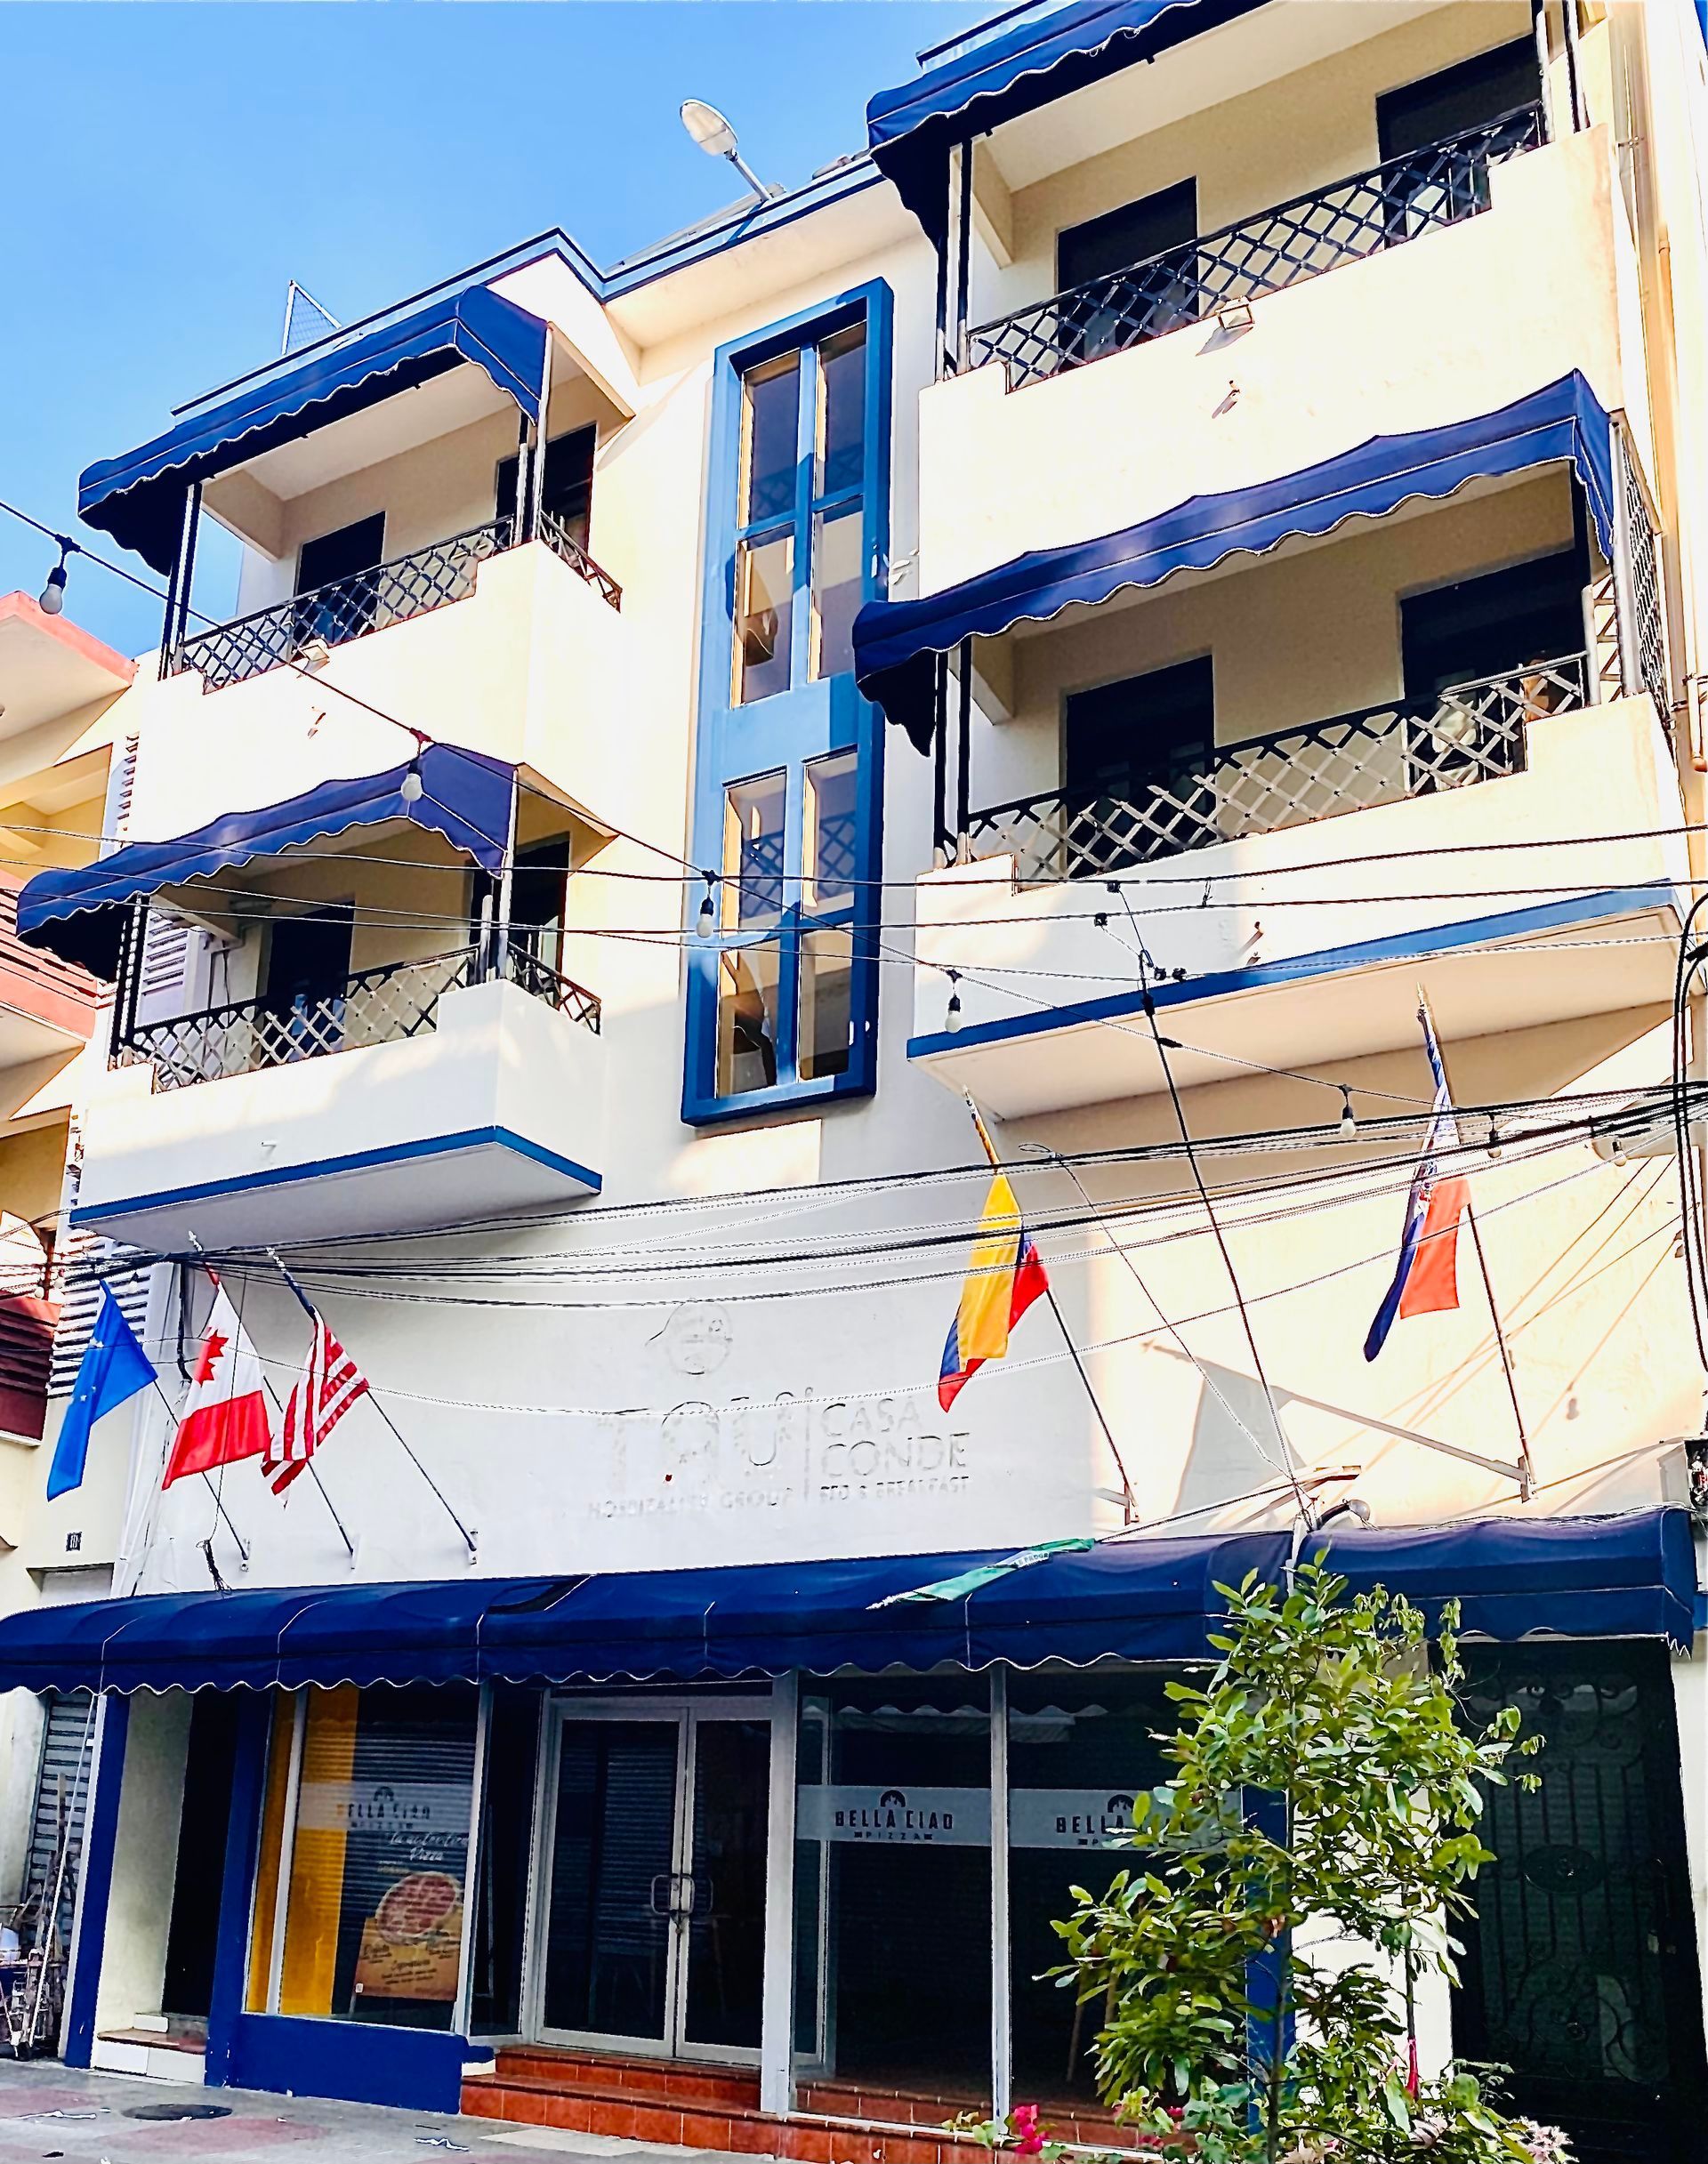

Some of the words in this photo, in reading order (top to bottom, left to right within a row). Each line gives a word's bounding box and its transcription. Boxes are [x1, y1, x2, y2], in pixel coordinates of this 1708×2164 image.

[821, 1397, 922, 1436] CASA
[822, 1433, 970, 1476] CONDE
[834, 1809, 896, 1828] BELLA
[906, 1810, 953, 1830] CIAO
[1056, 1815, 1125, 1834] BELLA
[866, 1831, 921, 1840] PIZZA
